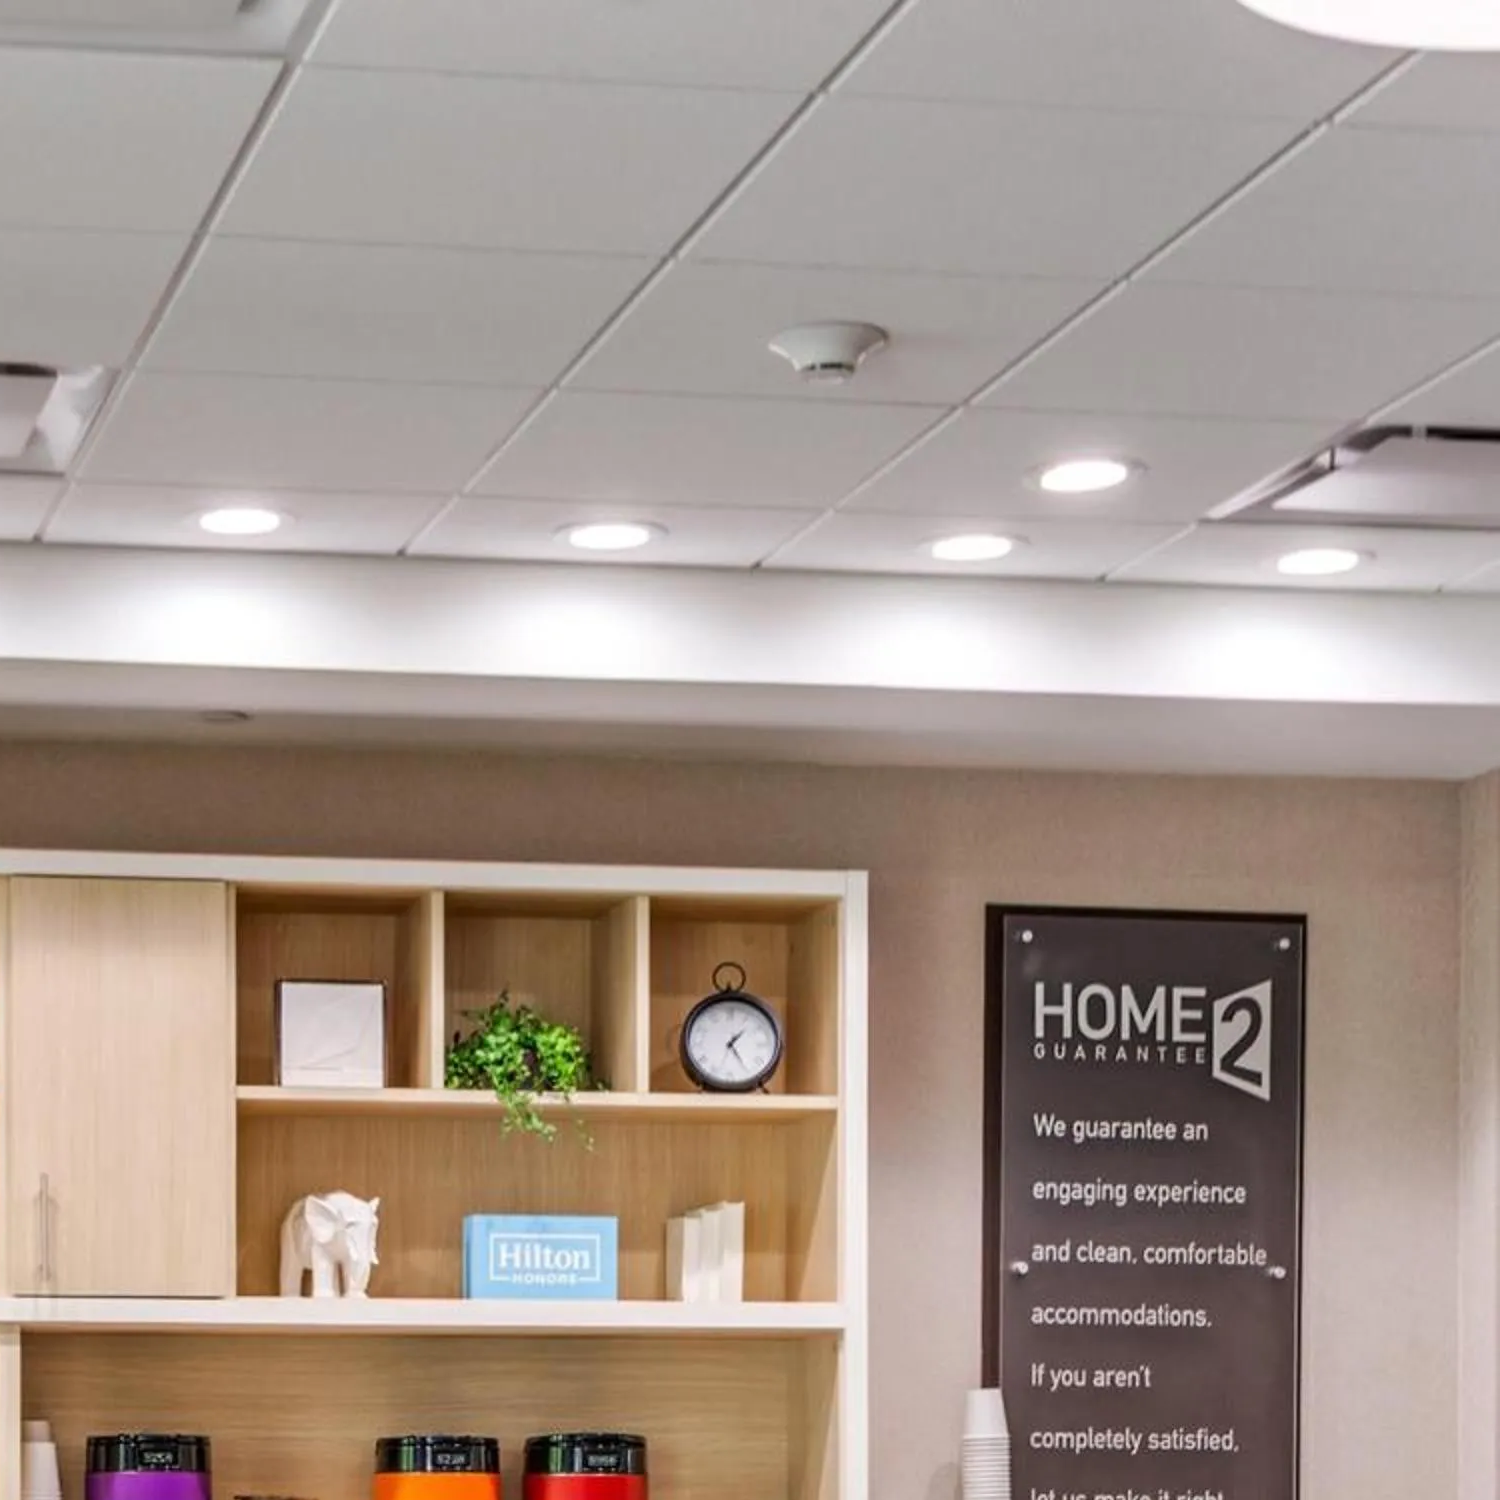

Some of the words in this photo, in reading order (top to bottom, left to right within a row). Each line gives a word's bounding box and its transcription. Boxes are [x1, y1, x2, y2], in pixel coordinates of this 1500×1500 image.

[1034, 981, 1207, 1043] HOME
[1219, 995, 1263, 1088] 2
[1033, 1043, 1207, 1064] GUARANTEE
[1033, 1113, 1067, 1137] We
[1073, 1117, 1177, 1143] guarantee
[1183, 1123, 1209, 1141] an
[1032, 1177, 1127, 1206] engaging
[1133, 1179, 1247, 1207] experience
[499, 1241, 591, 1270] Hilton
[1031, 1240, 1071, 1262] and
[1143, 1241, 1268, 1266] comfortable
[1031, 1303, 1213, 1327] accommodations.
[1030, 1362, 1045, 1386] If
[1050, 1368, 1087, 1392] you
[1093, 1365, 1151, 1388] aren't
[1030, 1426, 1143, 1455] completely
